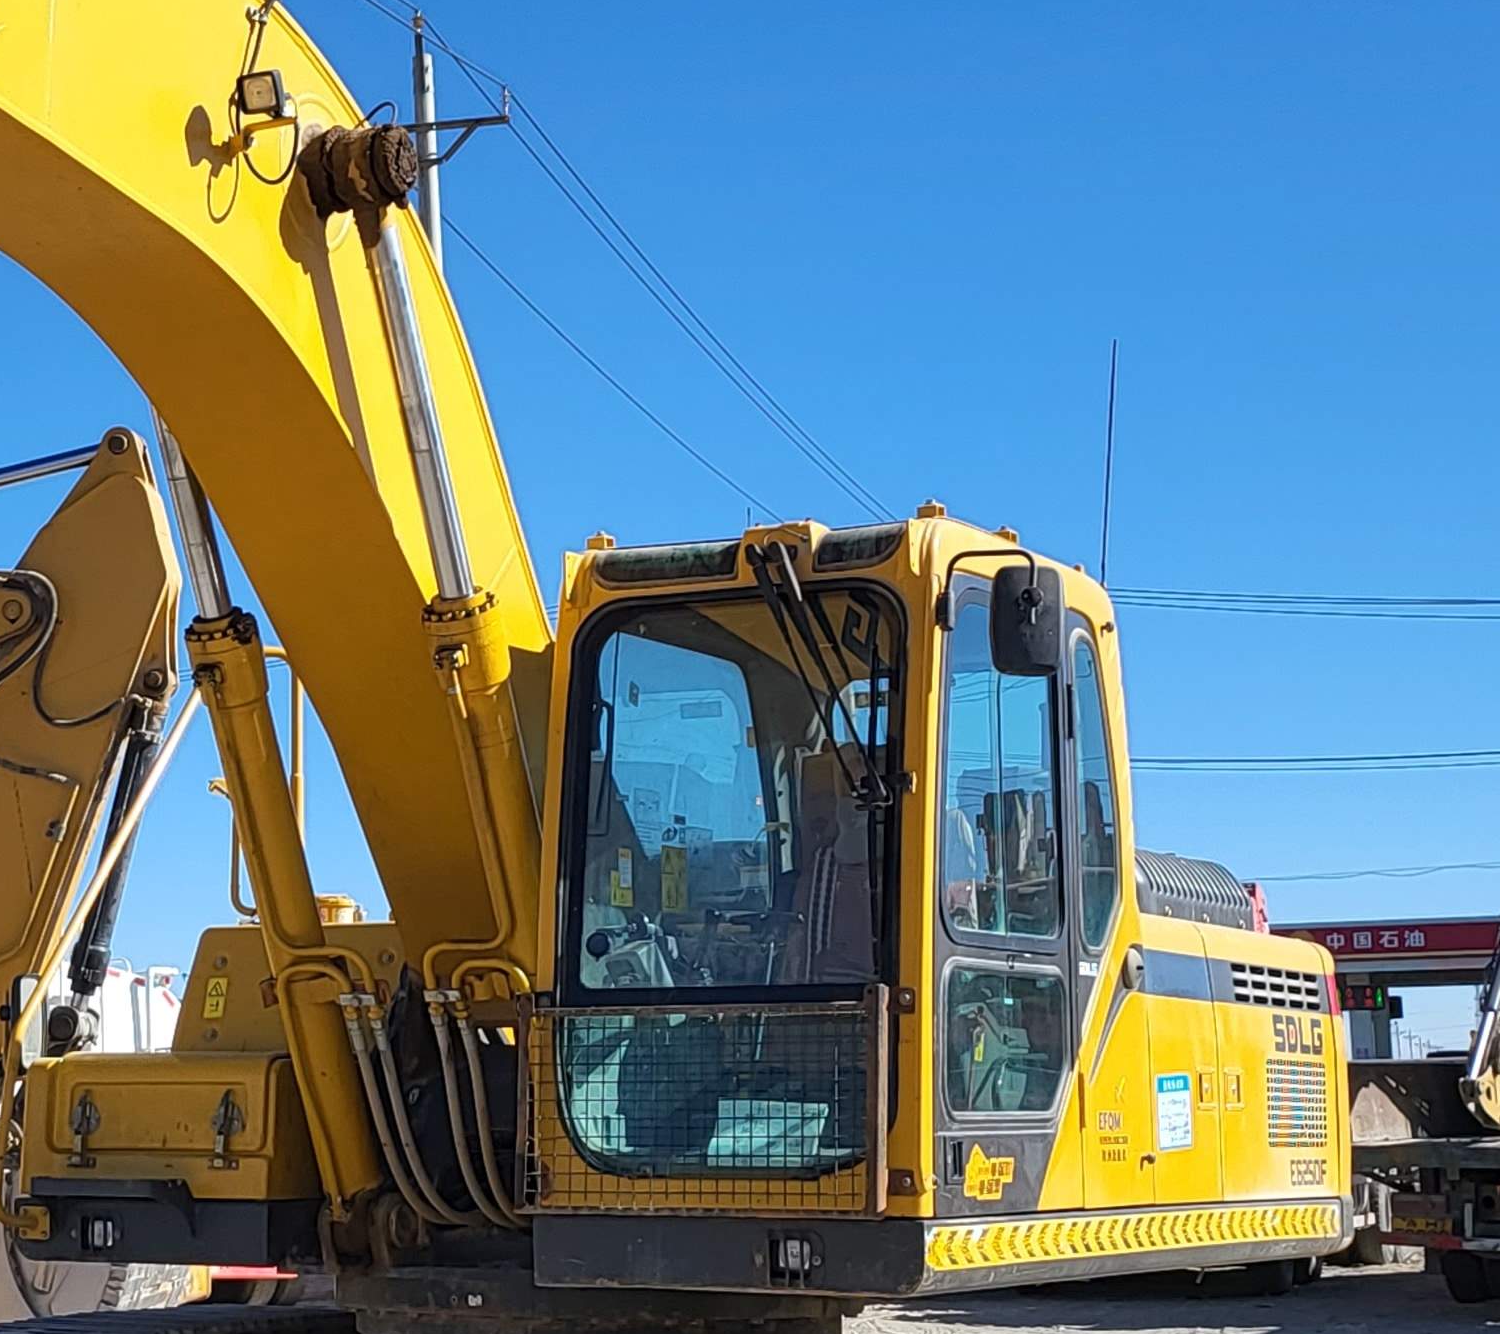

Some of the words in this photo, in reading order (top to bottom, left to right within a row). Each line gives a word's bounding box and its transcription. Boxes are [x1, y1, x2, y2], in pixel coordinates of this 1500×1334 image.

[1325, 929, 1426, 950] 中国石油
[1272, 1014, 1323, 1055] SDLG
